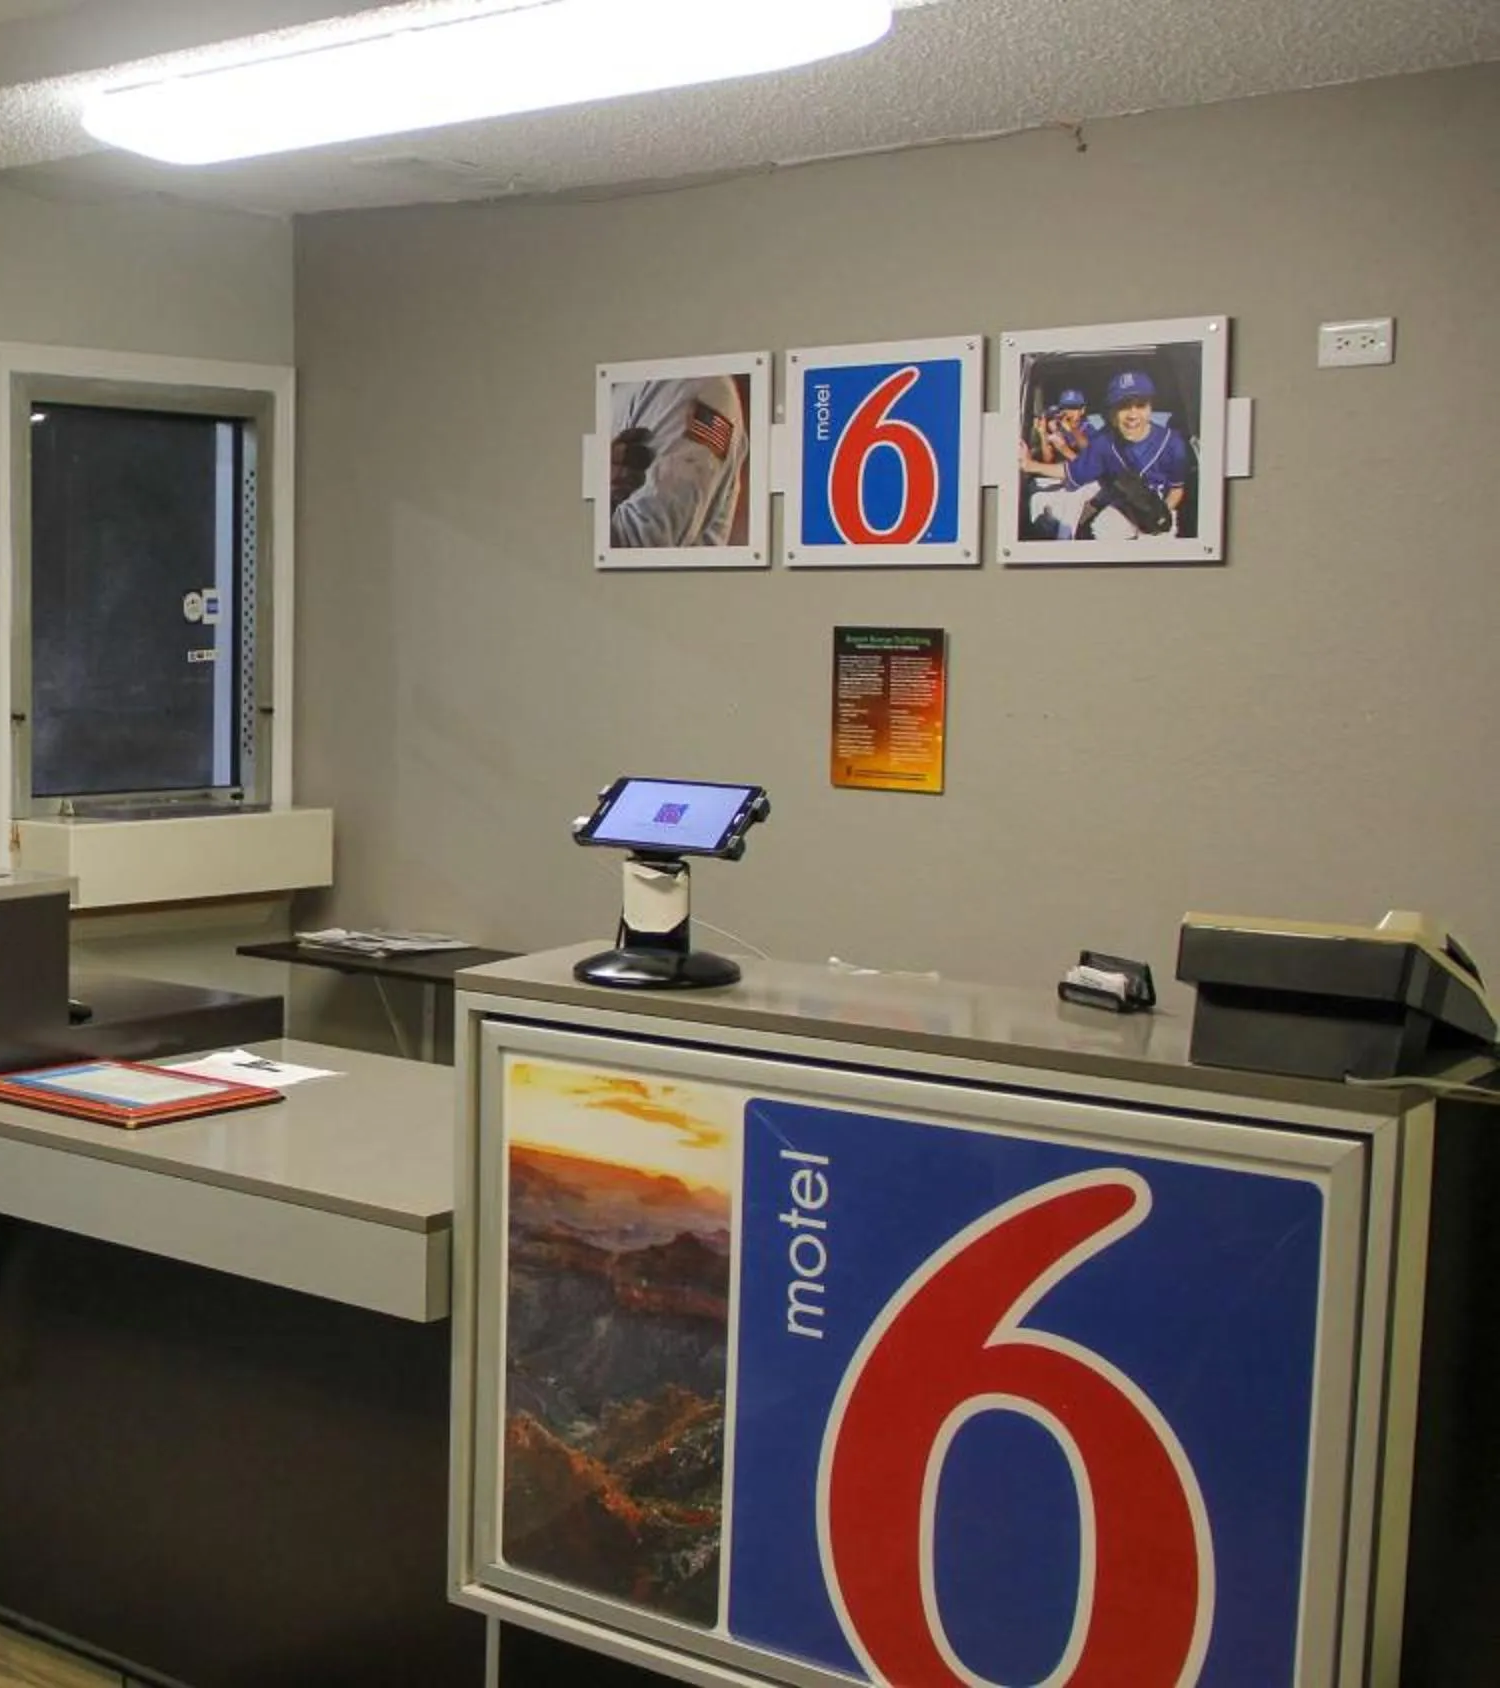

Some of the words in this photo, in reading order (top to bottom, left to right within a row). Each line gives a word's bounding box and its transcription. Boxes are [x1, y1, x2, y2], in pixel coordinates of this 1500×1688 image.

[814, 384, 831, 441] motel
[828, 366, 939, 545] 6
[781, 1148, 830, 1339] motel
[816, 1167, 1216, 1688] 6
